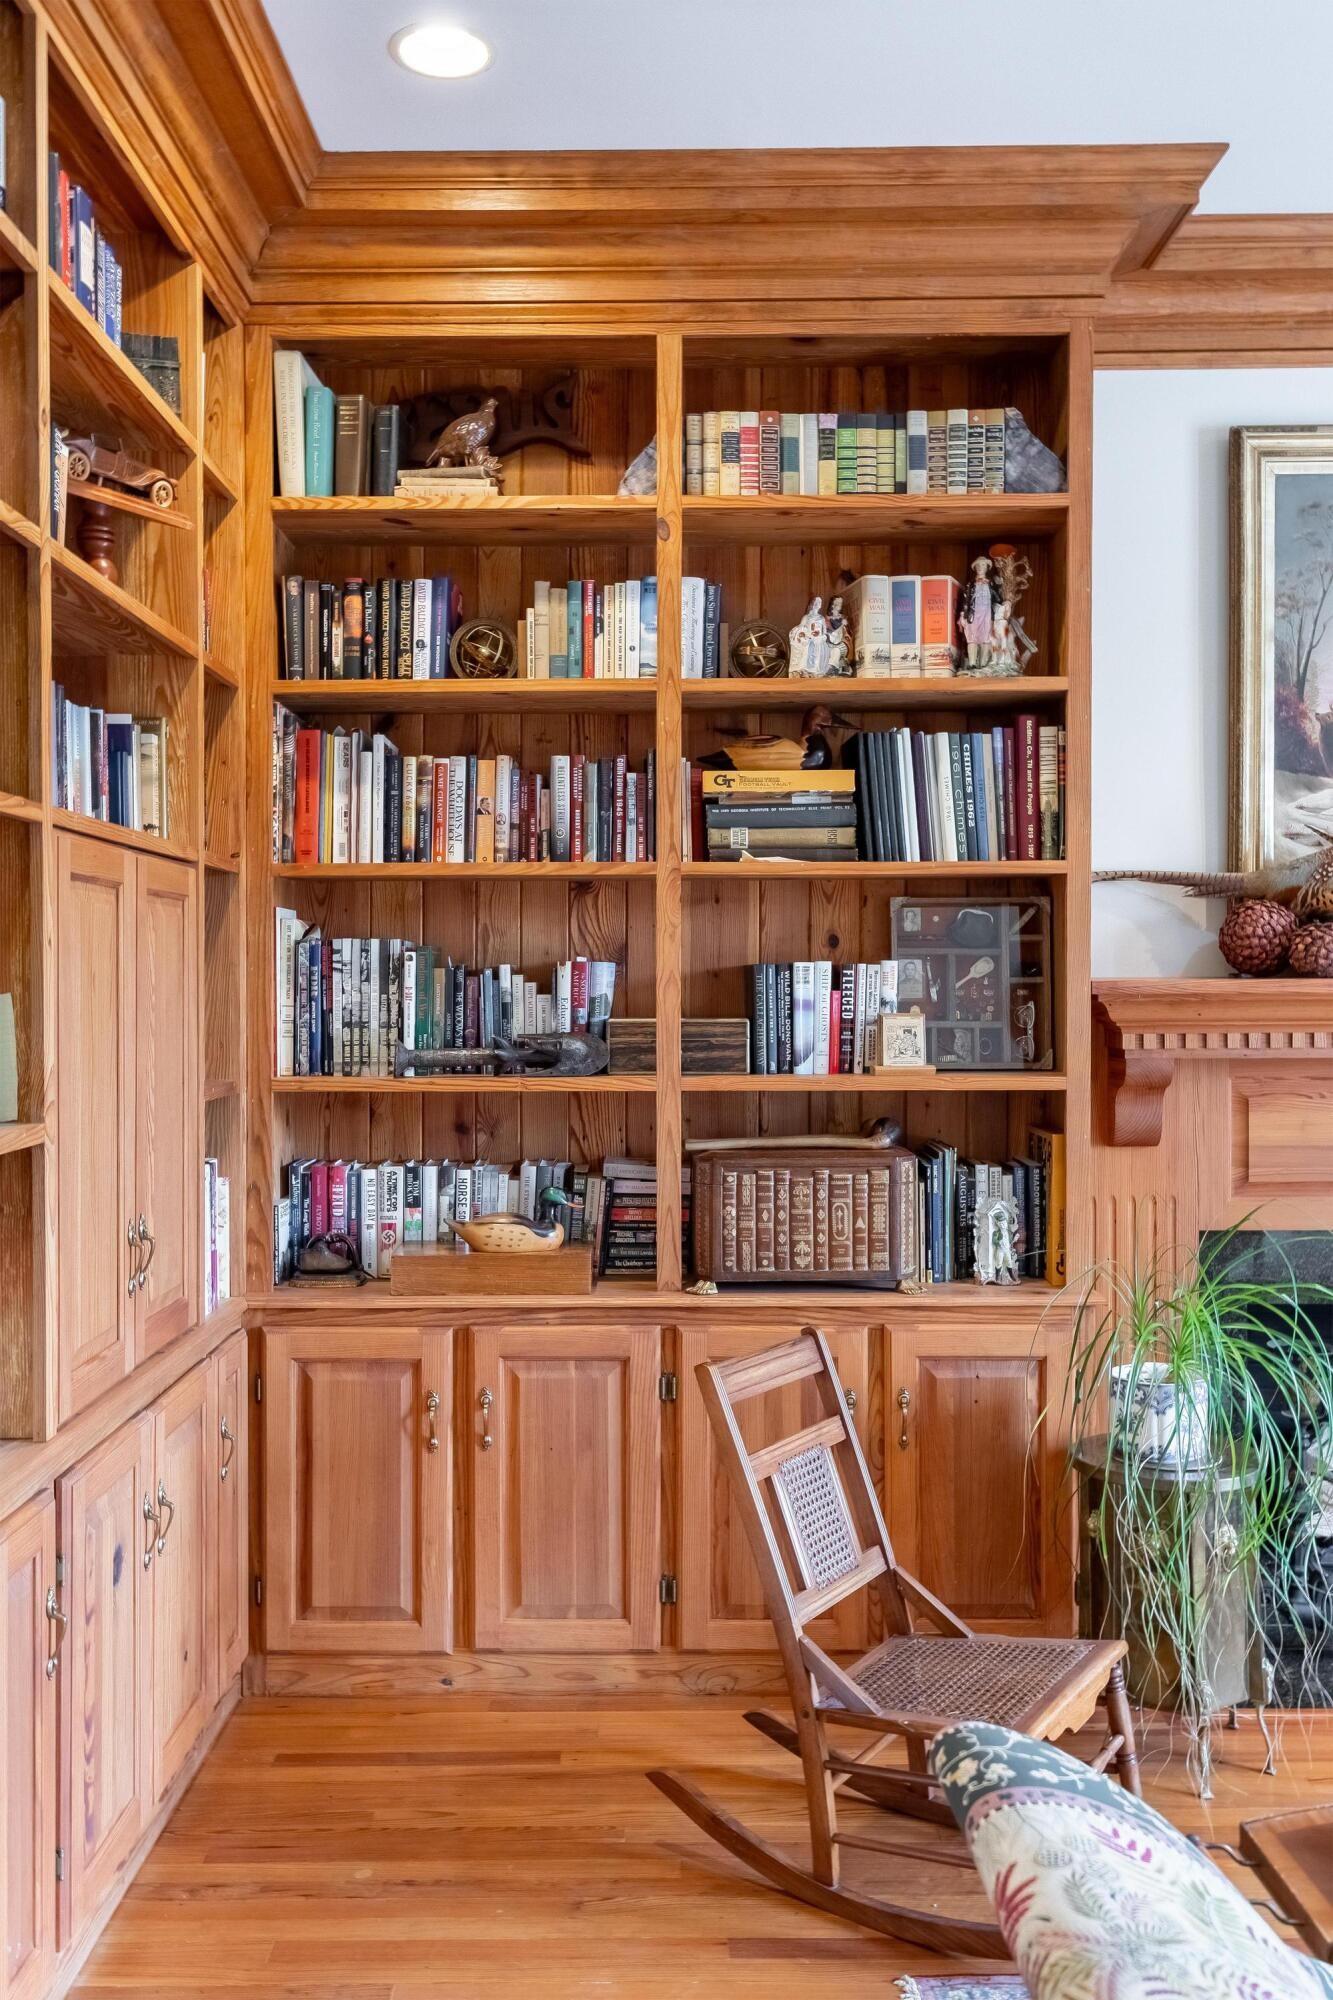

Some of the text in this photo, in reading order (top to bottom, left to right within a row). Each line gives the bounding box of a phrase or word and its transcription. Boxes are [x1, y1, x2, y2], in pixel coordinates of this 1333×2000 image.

[313, 422, 321, 439] Road
[382, 580, 390, 600] DAVID
[382, 601, 390, 631] BALDACCI
[400, 584, 411, 650] DAVID BALDACCI
[417, 582, 427, 639] DAVID BALDACCI
[707, 602, 716, 618] SHAW
[402, 652, 412, 676] SPLIT
[1026, 719, 1034, 745] McMinn
[1025, 745, 1033, 759] Co.,
[1027, 760, 1033, 769] TN
[1039, 735, 1057, 797] THE CIVIL WAR
[405, 763, 414, 811] LUCKY 666
[616, 758, 624, 796] COUNTDOWN
[714, 774, 736, 789] GT
[943, 776, 951, 803] CHIMES
[963, 743, 976, 828] CHIMES 1962
[437, 766, 445, 823] GAME CHANGE
[557, 765, 566, 825] RELENTLESS STRIKE
[616, 799, 624, 817] 1945
[951, 744, 968, 855] 1961 Chimes
[1025, 794, 1034, 816] People
[455, 780, 464, 844] DOG DAYS AT
[784, 970, 792, 994] WILD
[841, 969, 854, 1019] FLEECED
[419, 1000, 429, 1020] War
[455, 992, 464, 1038] THE WIDOW'S
[756, 975, 765, 1066] THE GALLAGHER WAY
[784, 995, 792, 1017] BILL
[820, 968, 829, 1042] SHIP OF GHOSTS
[291, 1181, 301, 1206] Midway
[332, 1187, 344, 1216] FEUD
[367, 1178, 376, 1222] NO EASY DAY
[406, 1173, 414, 1204] BROKAW
[457, 1177, 468, 1208] HORSE
[959, 1173, 967, 1227] AUGUSTUS
[1032, 1168, 1040, 1205] SHADOW
